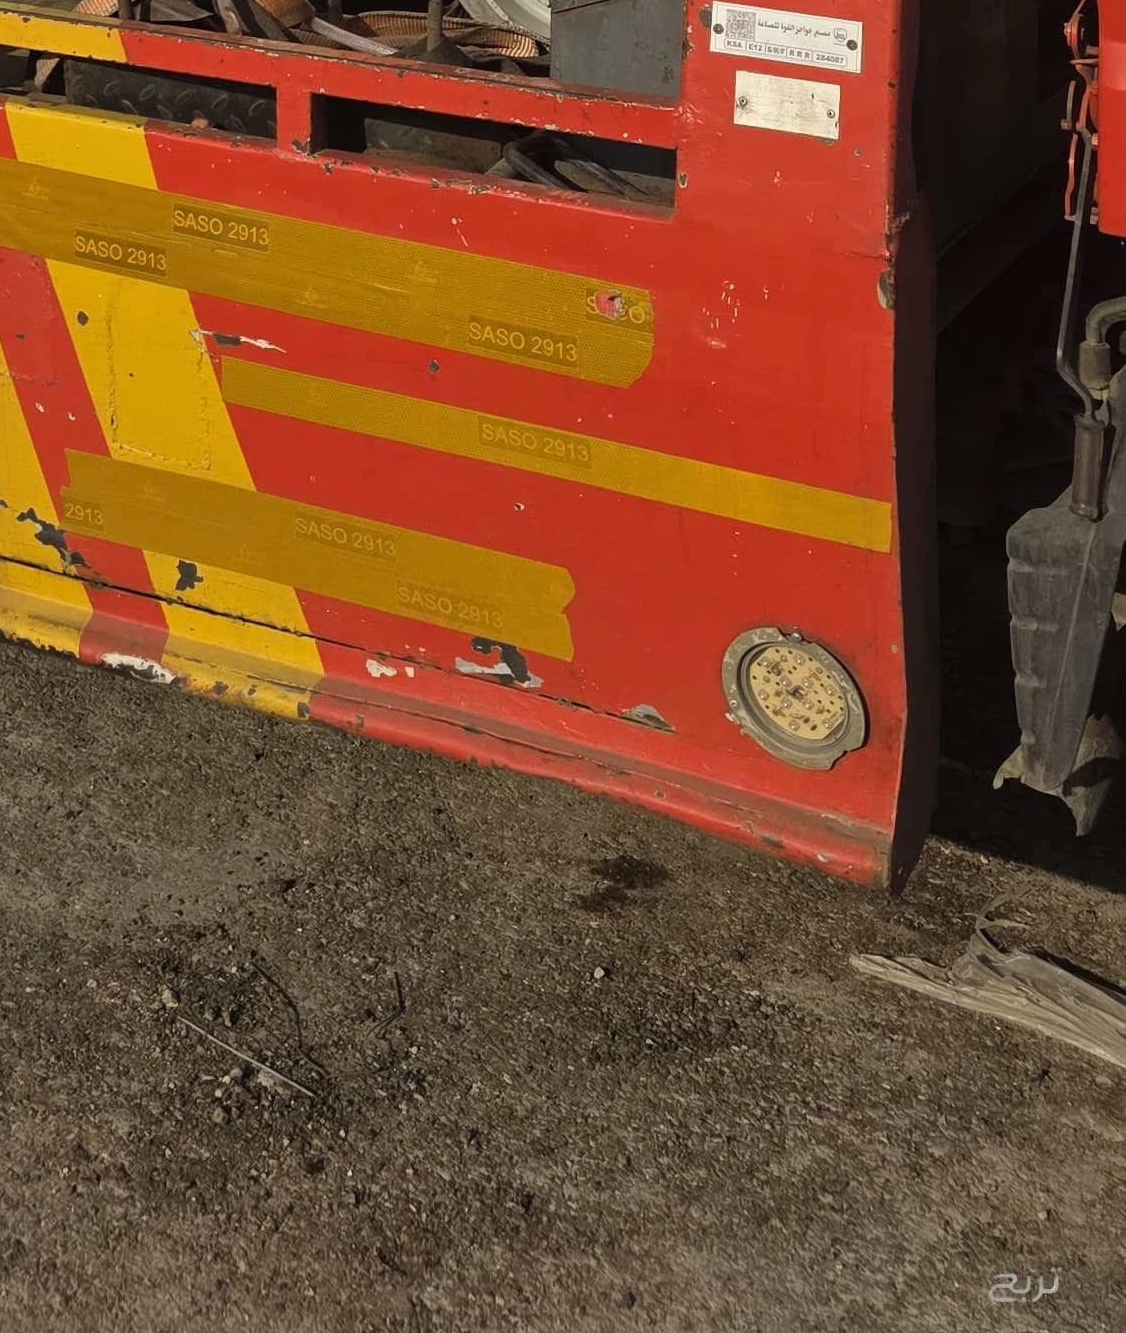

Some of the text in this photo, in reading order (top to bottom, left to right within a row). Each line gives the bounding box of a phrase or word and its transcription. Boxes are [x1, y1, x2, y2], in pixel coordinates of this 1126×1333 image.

[174, 210, 269, 245] SASO 2913
[75, 236, 167, 270] SASO 2913
[469, 322, 577, 362] SASO 2913
[482, 423, 588, 462] SASO 2913
[65, 503, 104, 526] 2913
[294, 517, 396, 558] SASO 2913
[396, 587, 452, 614] SASO
